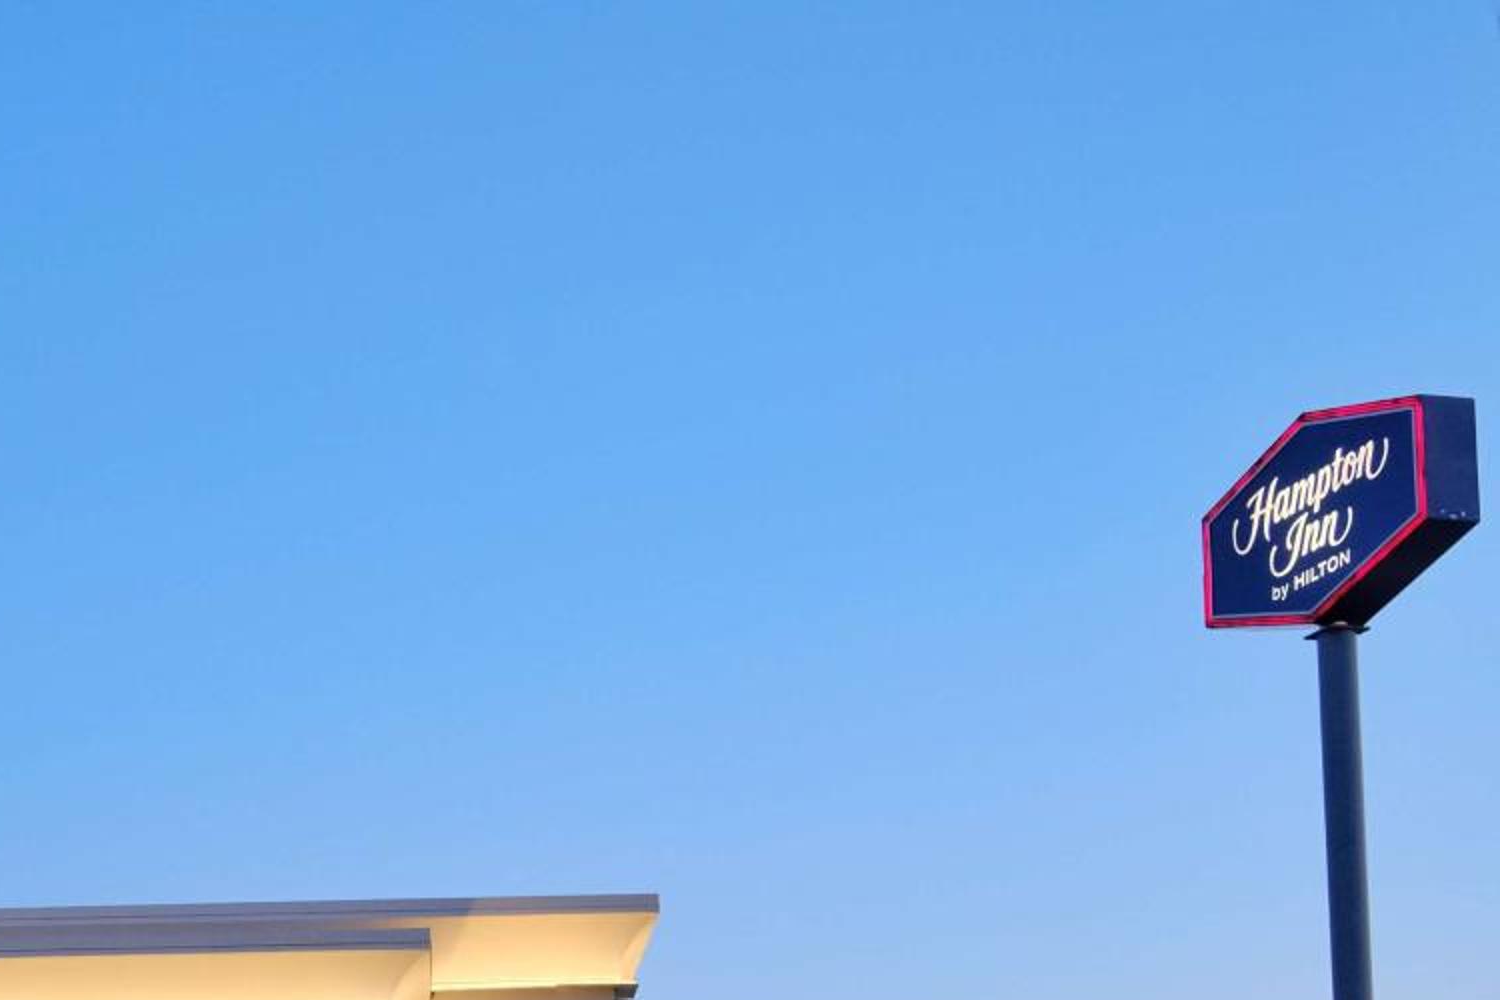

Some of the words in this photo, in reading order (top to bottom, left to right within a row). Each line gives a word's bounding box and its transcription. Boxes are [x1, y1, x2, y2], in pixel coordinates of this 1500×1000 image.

[1232, 437, 1389, 555] Hampton
[1269, 506, 1353, 578] Inn
[1271, 583, 1289, 601] by
[1293, 549, 1351, 590] HILTON
